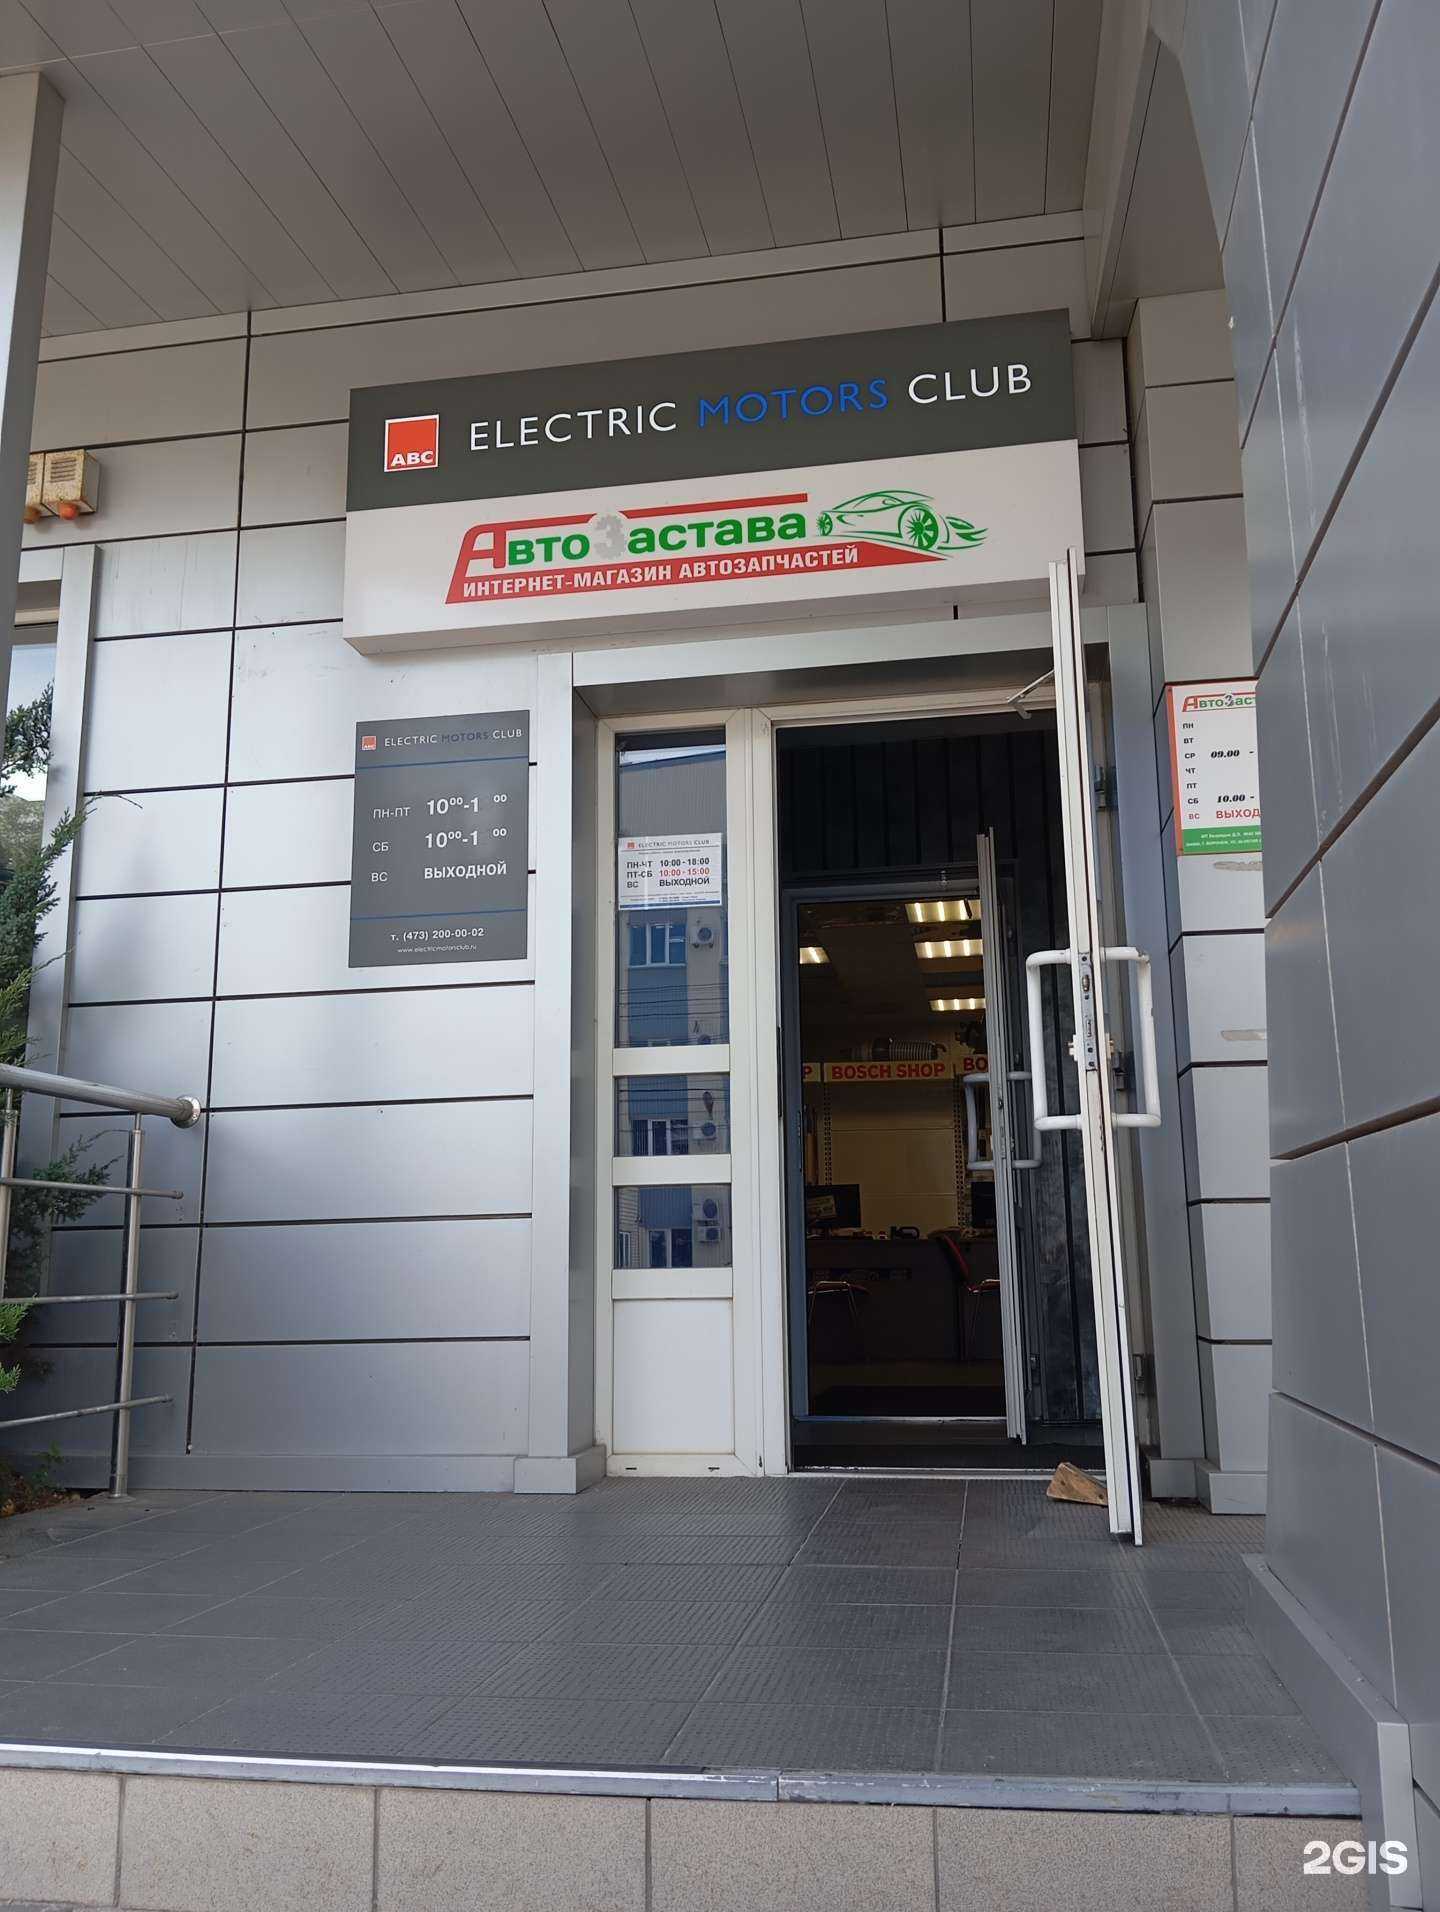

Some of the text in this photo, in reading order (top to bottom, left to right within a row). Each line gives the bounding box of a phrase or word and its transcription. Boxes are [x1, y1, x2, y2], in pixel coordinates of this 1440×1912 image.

[470, 364, 1032, 451] ELECTRIC MOTORS CLUB
[391, 450, 434, 467] ABC
[462, 544, 859, 598] ИНТЕРНЕТ-МАГАЗИН АВТОЗАПЧАСТЕЙ
[384, 735, 437, 747] ELECTRIC
[442, 731, 489, 743] MOTORS
[492, 729, 522, 739] CLUB
[1210, 750, 1240, 759] 09.00
[1217, 794, 1246, 803] 10.00
[373, 807, 411, 819] ПН-ПТ
[1216, 808, 1261, 819] ВЫХОД
[372, 842, 389, 852] СБ
[626, 861, 653, 869] ПН-ЧТ
[660, 859, 681, 867] 10:00
[371, 860, 507, 882] ВС ВЫХОДНОЙ
[626, 871, 653, 879] ПТ-СБ
[660, 869, 681, 877] 10:00
[688, 867, 710, 876] 15:00
[659, 876, 710, 887] ВЫХОДНОЙ
[403, 930, 429, 942] (473)
[432, 927, 484, 939] 200-00-02
[831, 1064, 892, 1080] BOSCH
[896, 1062, 946, 1078] SHOP
